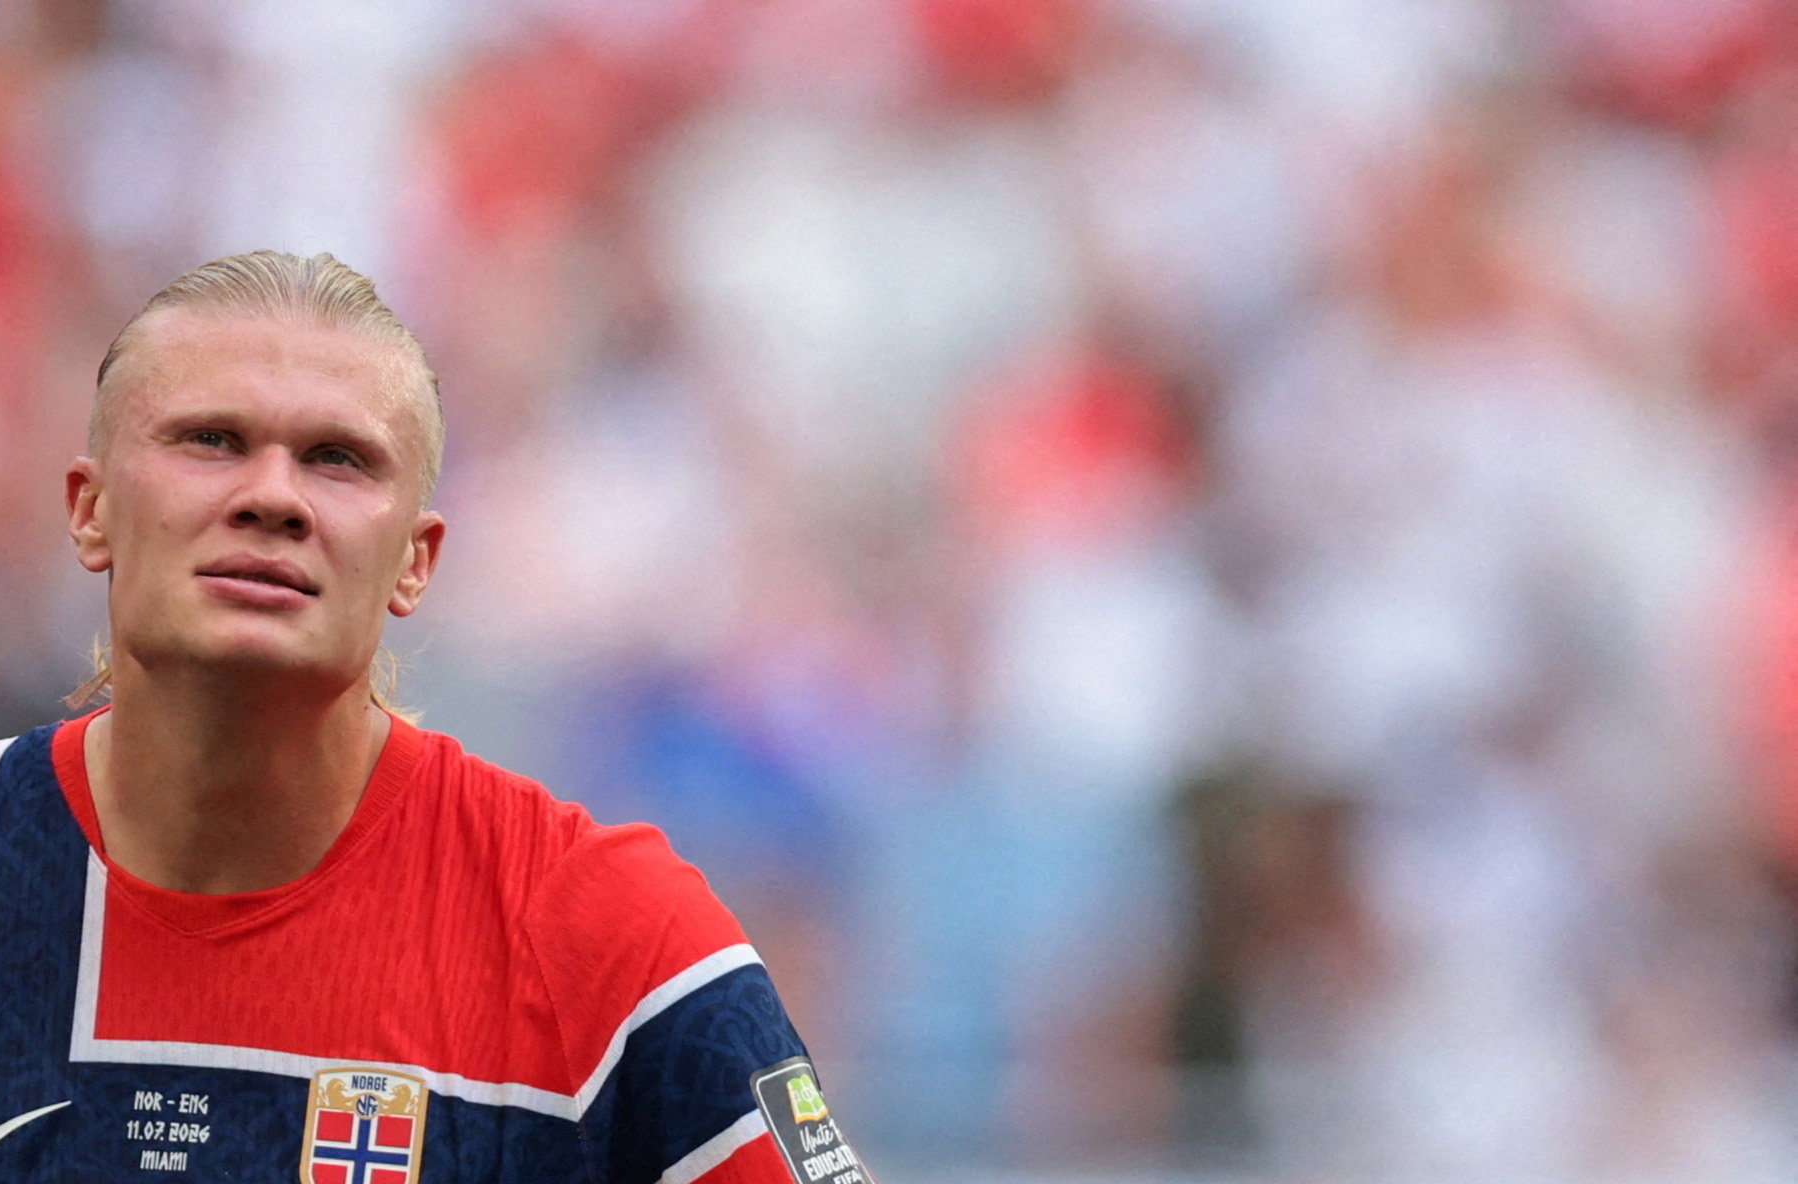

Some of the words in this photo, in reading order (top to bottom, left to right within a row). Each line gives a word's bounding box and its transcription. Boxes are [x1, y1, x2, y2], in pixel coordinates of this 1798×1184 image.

[351, 1075, 388, 1092] NORGE
[134, 1090, 163, 1111] NOR
[178, 1093, 209, 1115] ENG
[140, 1149, 188, 1172] MIAMI
